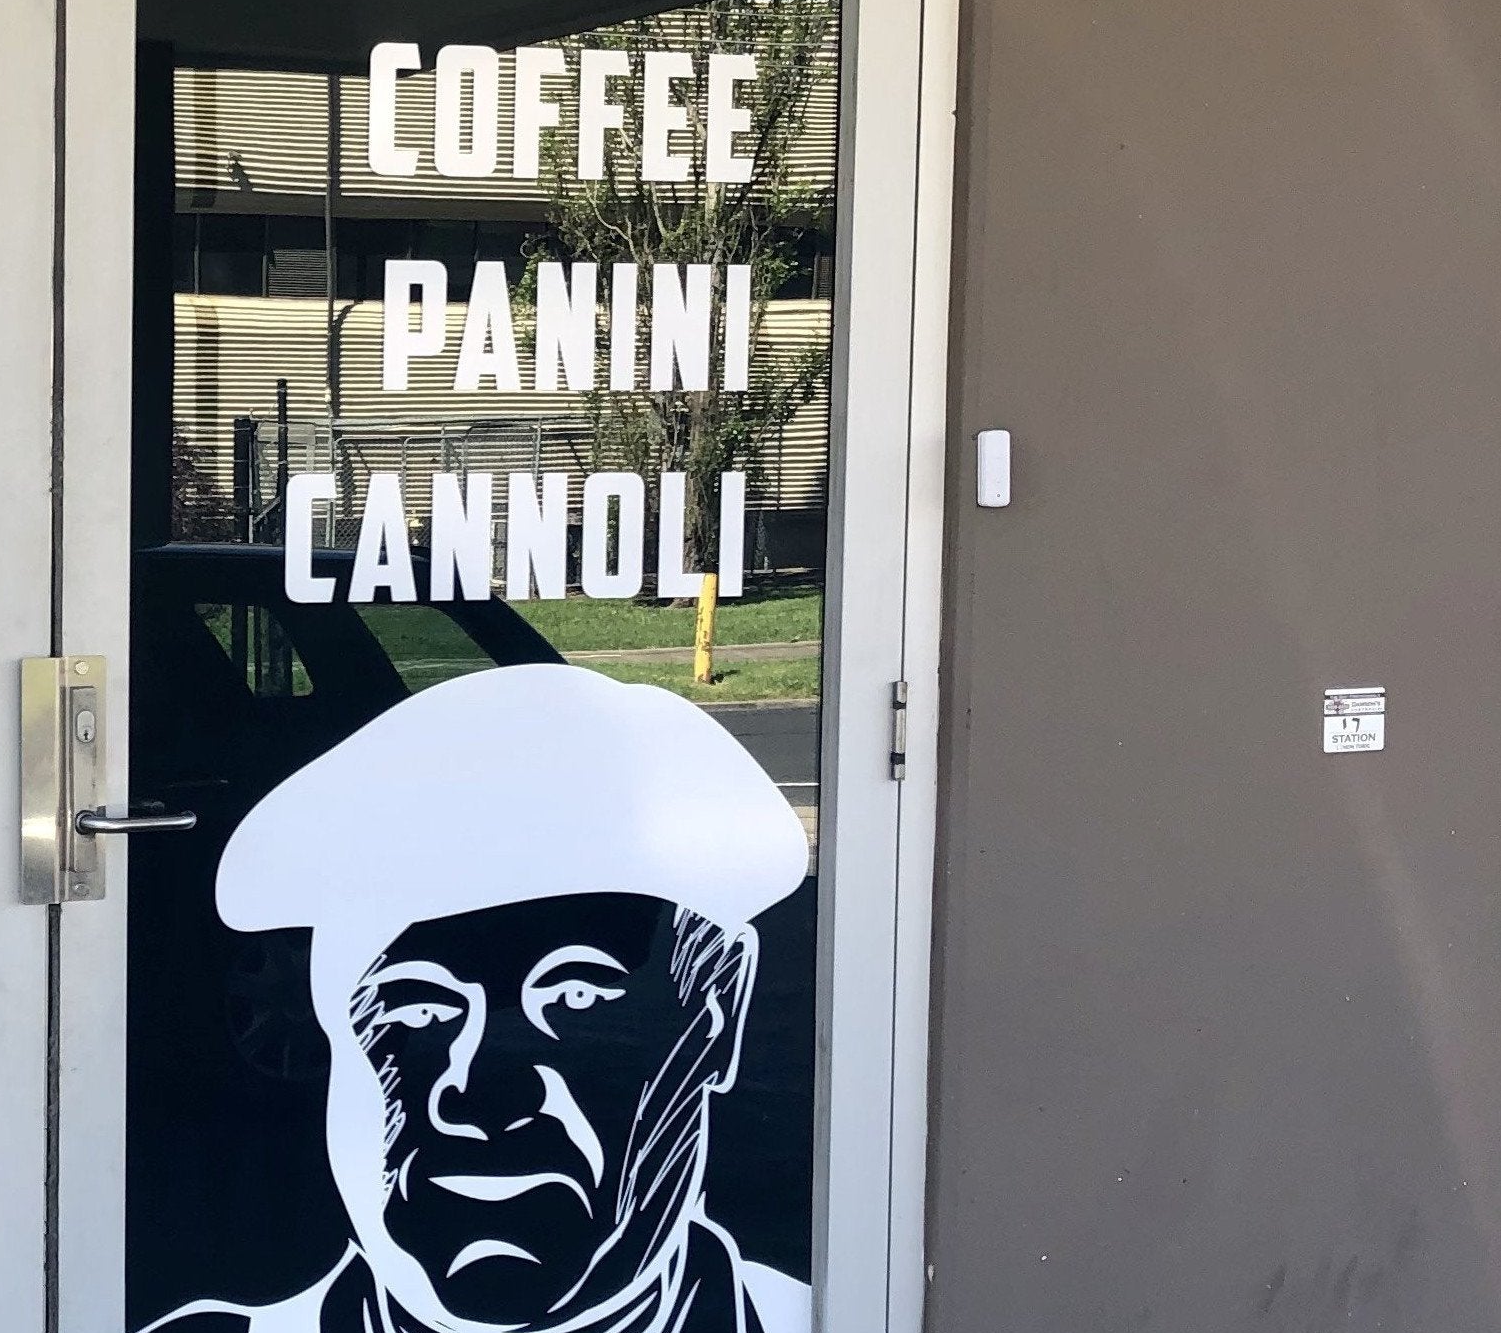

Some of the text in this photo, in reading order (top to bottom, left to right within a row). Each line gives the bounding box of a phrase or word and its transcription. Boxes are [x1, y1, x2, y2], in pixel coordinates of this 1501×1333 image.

[369, 42, 756, 183] COFFEE
[382, 260, 750, 392] PANINI
[286, 471, 745, 604] CANNOLI
[1332, 733, 1376, 744] STATION
